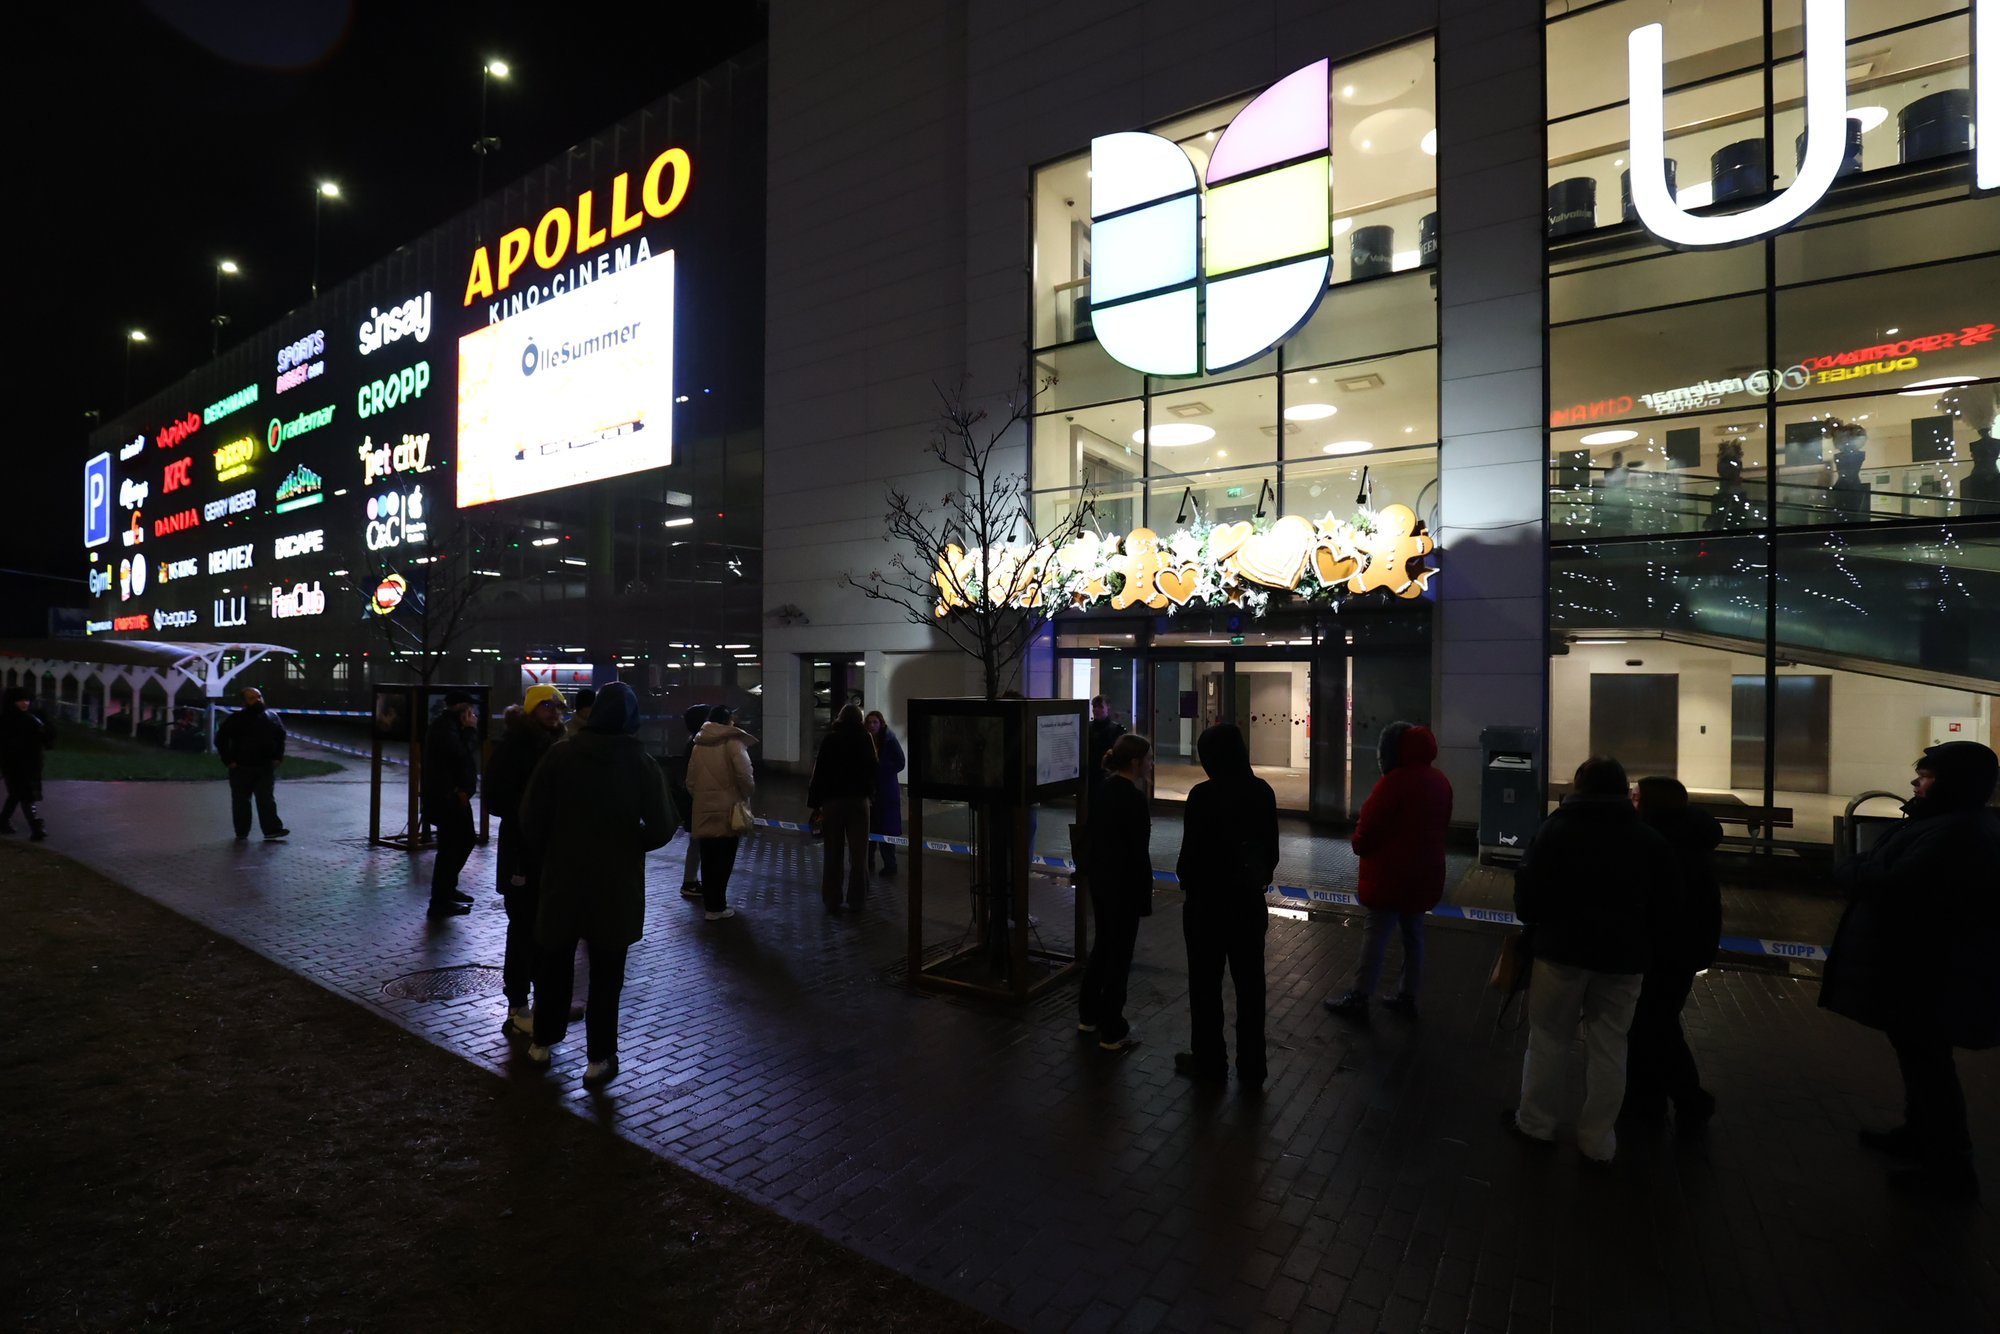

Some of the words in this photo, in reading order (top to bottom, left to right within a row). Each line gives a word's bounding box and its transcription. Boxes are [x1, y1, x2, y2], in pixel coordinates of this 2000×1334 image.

[464, 148, 691, 307] APOLLO
[359, 291, 431, 355] sinsay
[277, 329, 325, 374] SPORTS
[203, 383, 258, 425] DEICHMANN
[358, 361, 430, 419] CROPP
[282, 404, 336, 441] rademar
[163, 456, 193, 494] KFC
[364, 443, 392, 486] pet
[393, 433, 432, 473] city
[90, 472, 104, 530] P
[204, 498, 228, 522] GERRY
[228, 489, 256, 514] WEBER
[155, 508, 200, 537] DANIJA
[366, 516, 400, 551] C&C
[208, 543, 254, 575] HEMTEX
[1313, 890, 1351, 903] POLITSEI
[1469, 908, 1514, 923] POLITSEI
[1772, 942, 1816, 958] STOPP
